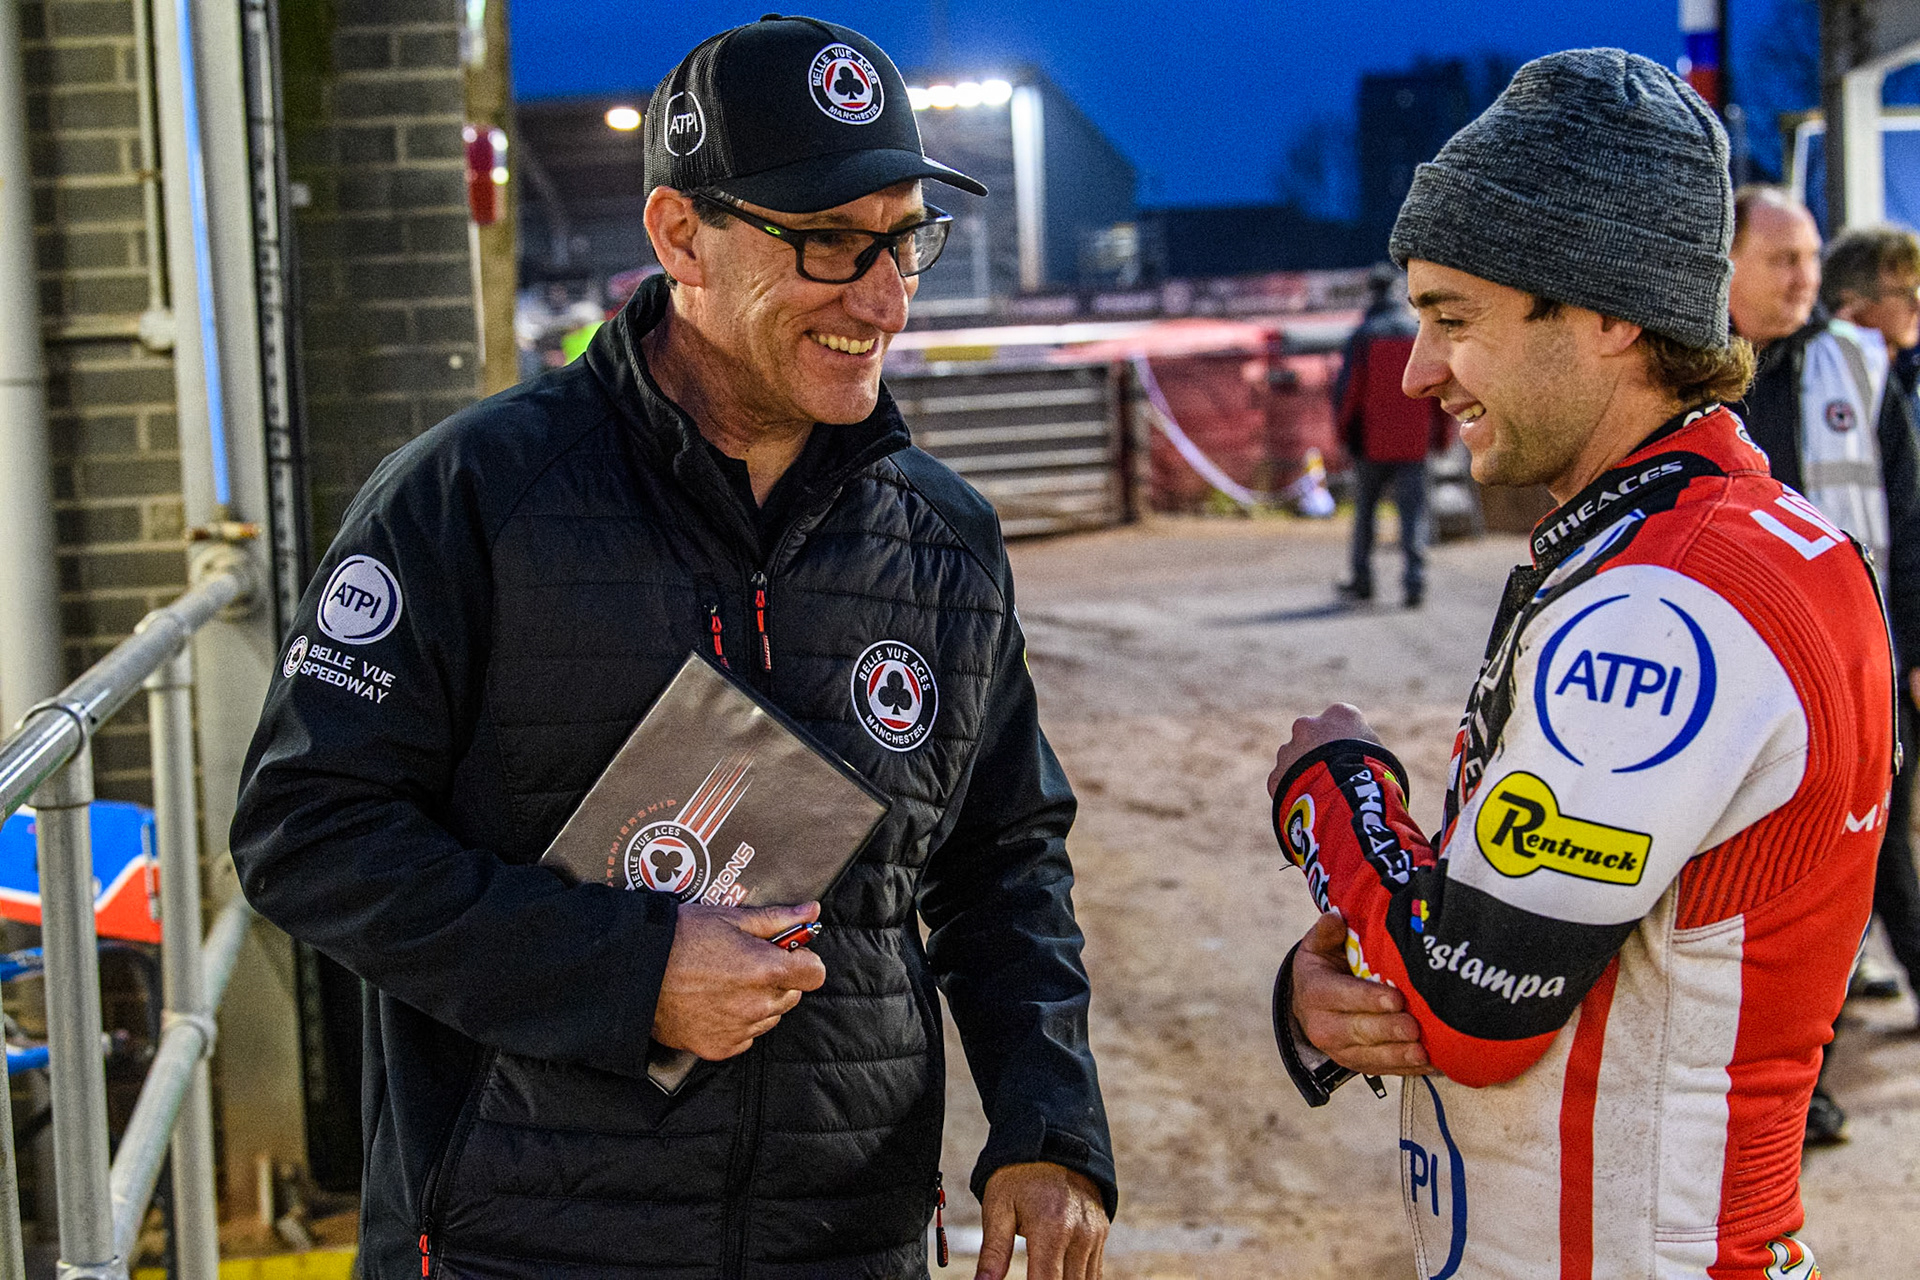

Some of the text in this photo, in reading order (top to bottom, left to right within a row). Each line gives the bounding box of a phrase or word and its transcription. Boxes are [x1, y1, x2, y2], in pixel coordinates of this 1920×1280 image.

[812, 54, 831, 87] BELLE
[831, 48, 853, 60] VUE
[669, 111, 699, 136] ATPI
[828, 103, 879, 121] MANCHESTER
[329, 581, 382, 619] ATPI
[300, 660, 389, 704] SPEEDWAY
[308, 644, 356, 670] BELLE
[362, 660, 397, 688] VUE
[858, 647, 932, 692] BELLE VUE ACES
[1554, 649, 1682, 717] ATPI
[865, 714, 926, 745] MANCHESTER
[1490, 790, 1638, 872] Rentruck
[630, 826, 681, 888] BELLE VUE ACES
[1399, 1138, 1440, 1217] PI
